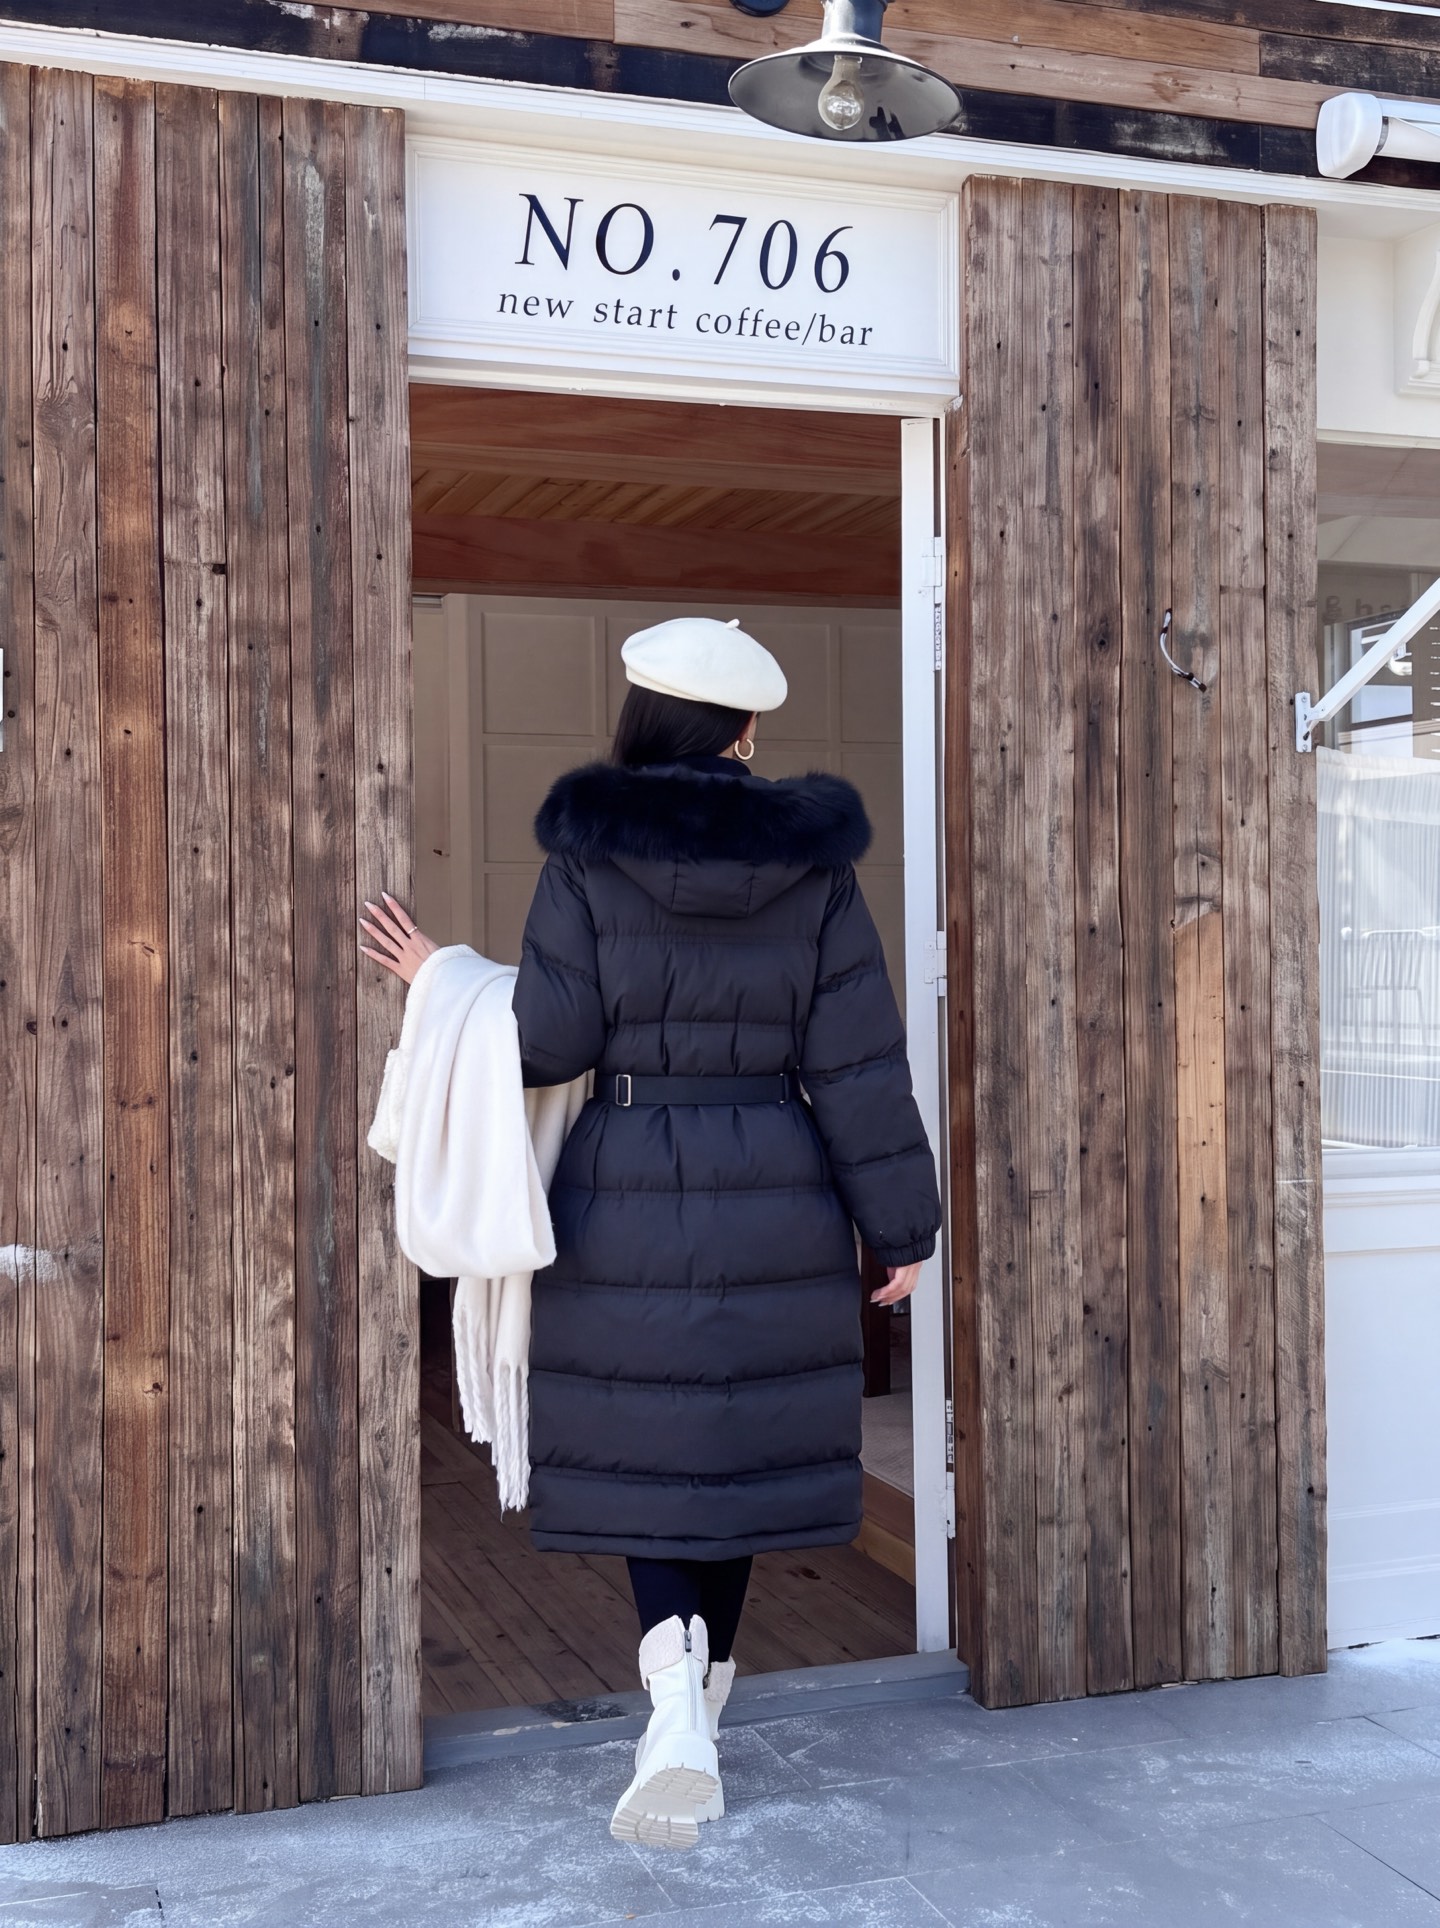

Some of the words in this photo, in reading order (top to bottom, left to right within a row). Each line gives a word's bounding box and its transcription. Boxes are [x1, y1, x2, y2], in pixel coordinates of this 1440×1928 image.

[497, 292, 575, 320] new
[593, 298, 679, 330] start
[694, 306, 874, 347] coffee/bar
